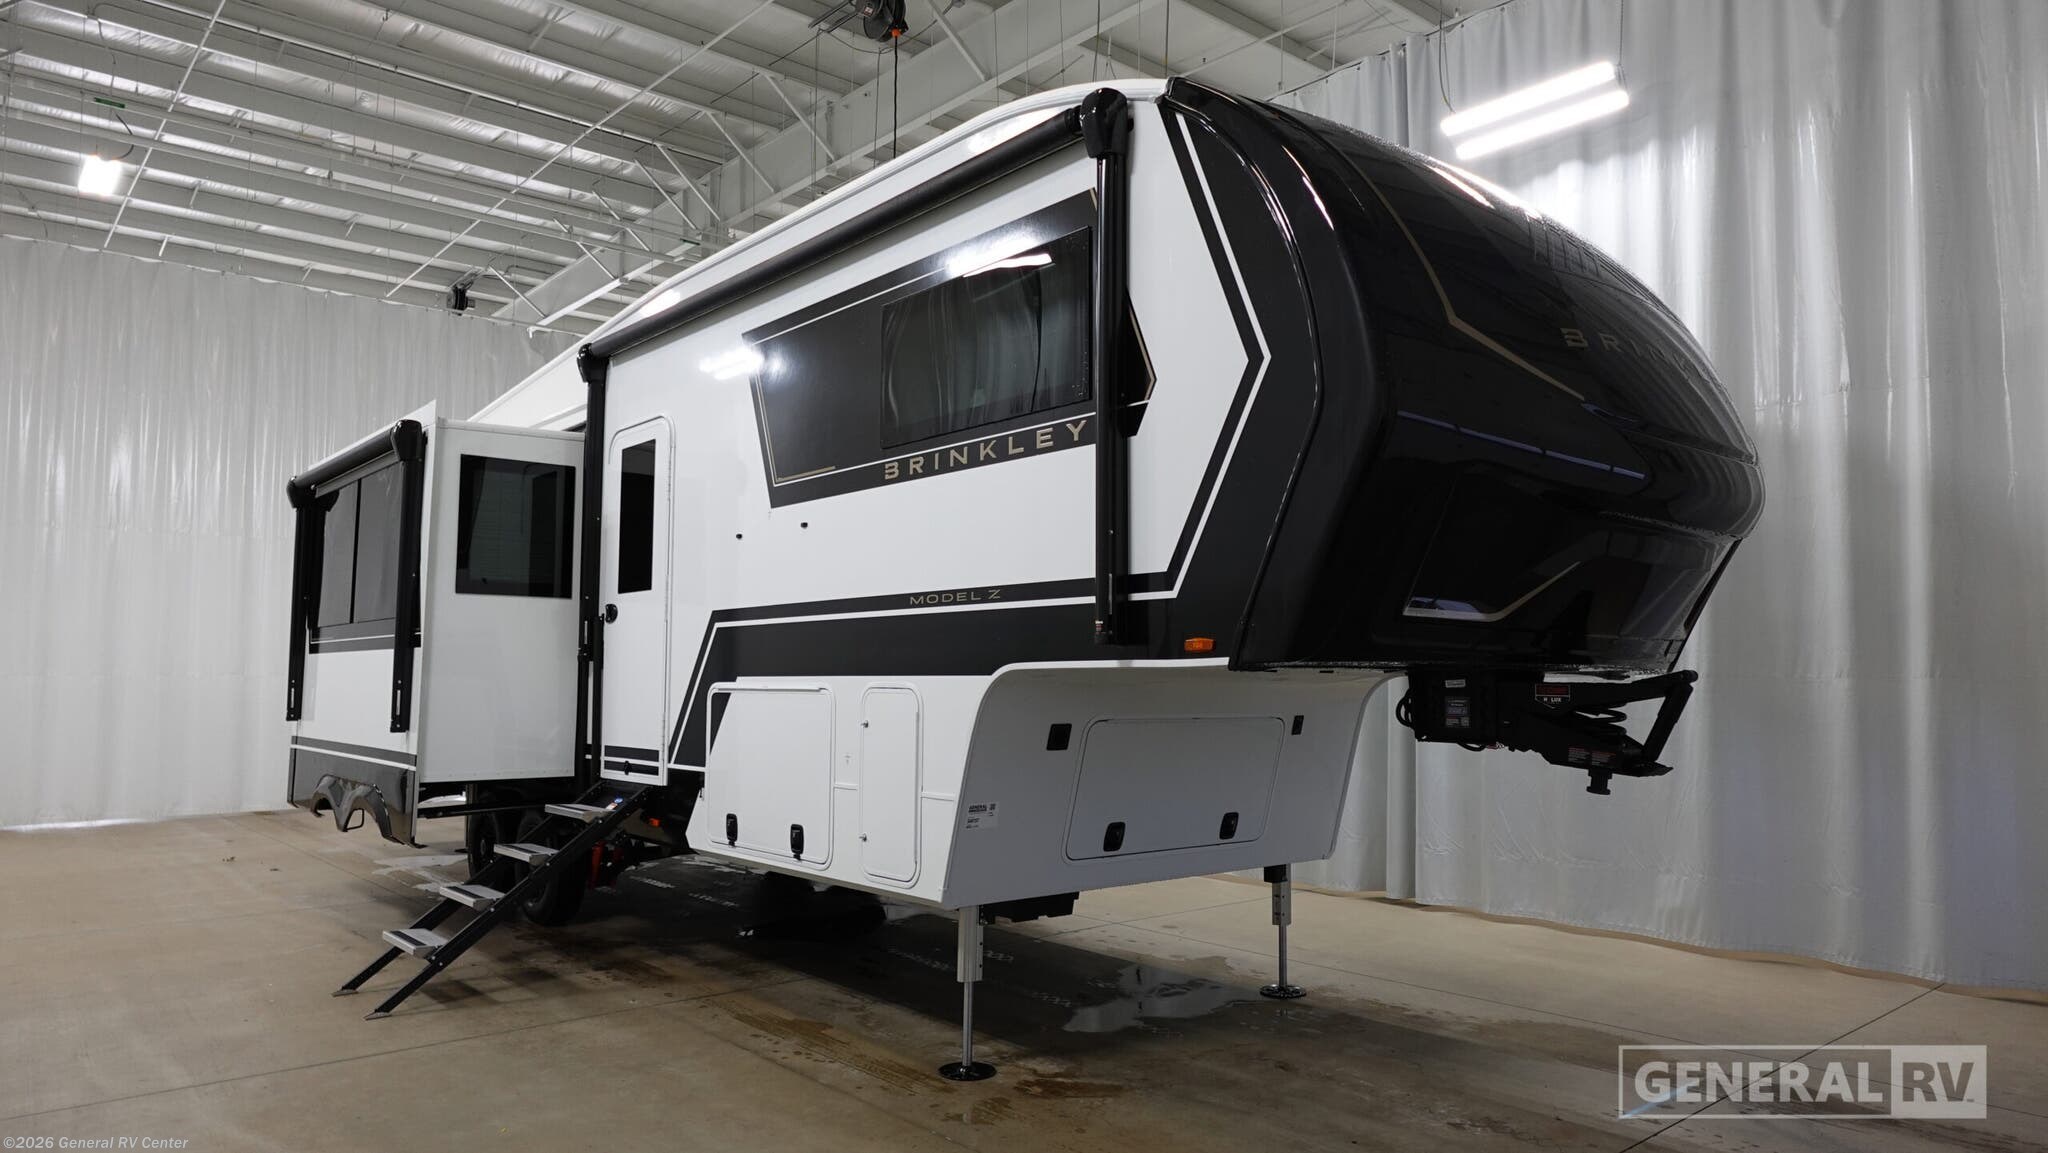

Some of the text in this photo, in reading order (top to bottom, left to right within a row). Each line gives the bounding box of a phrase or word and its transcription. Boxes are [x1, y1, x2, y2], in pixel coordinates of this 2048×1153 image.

[884, 419, 1088, 480] BRINKLEY
[909, 589, 1001, 605] MODEL Z
